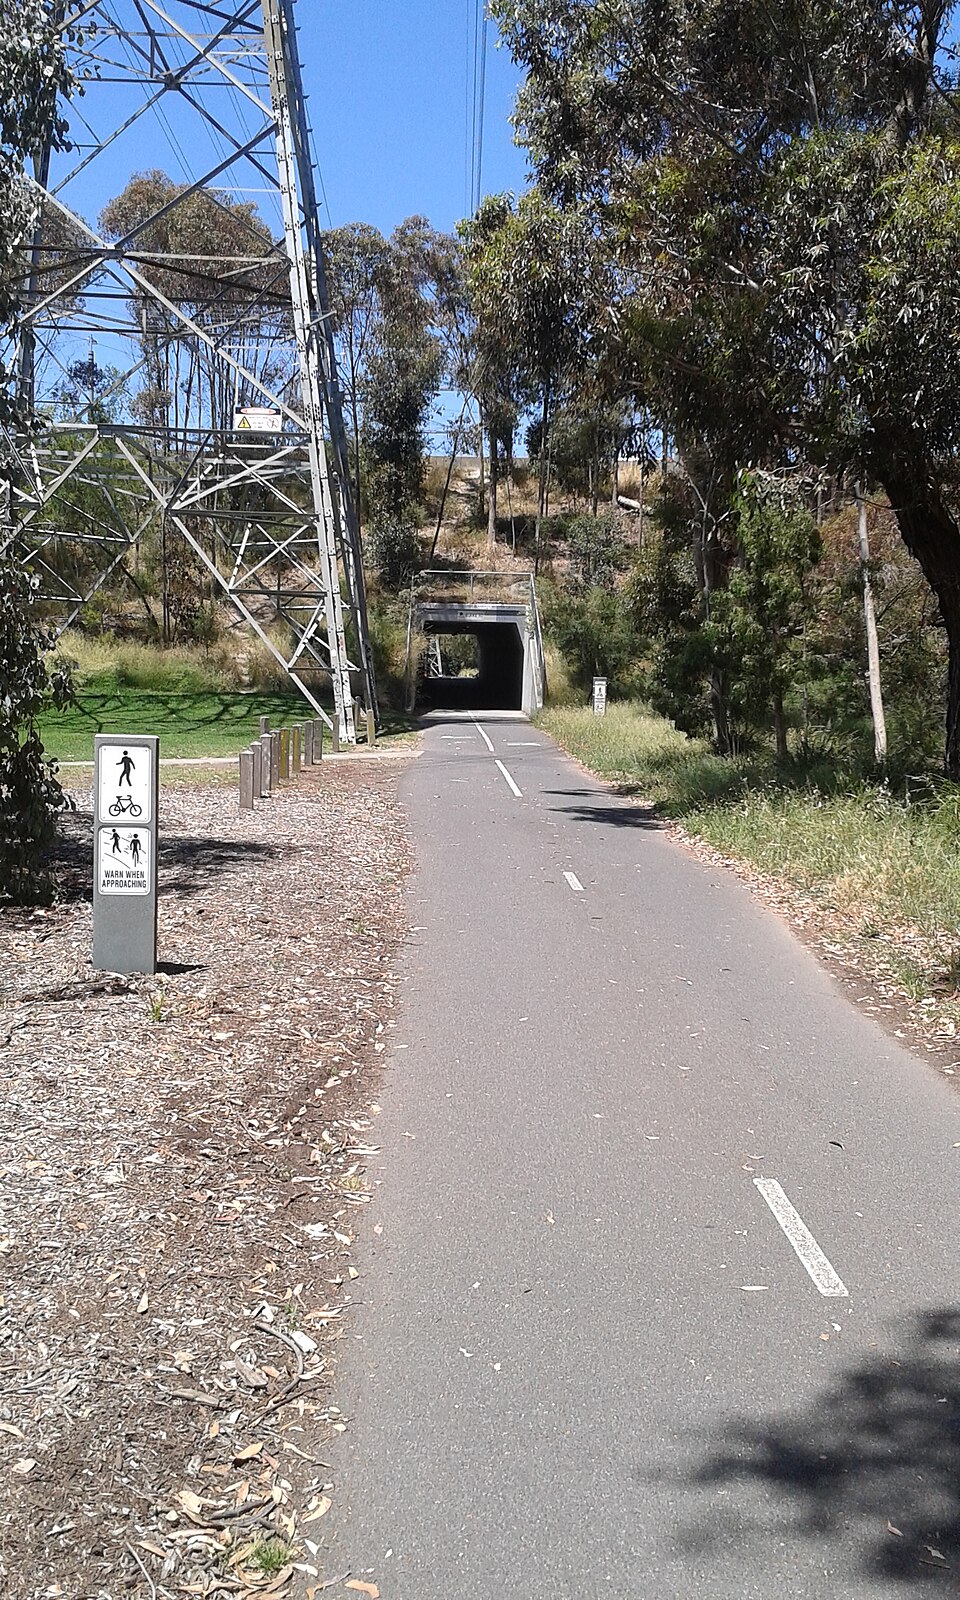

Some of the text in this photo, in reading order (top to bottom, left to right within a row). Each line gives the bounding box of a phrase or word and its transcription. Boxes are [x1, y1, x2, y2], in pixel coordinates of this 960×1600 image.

[104, 870, 145, 879] WARN WHEN
[101, 879, 147, 888] APPROACHING
